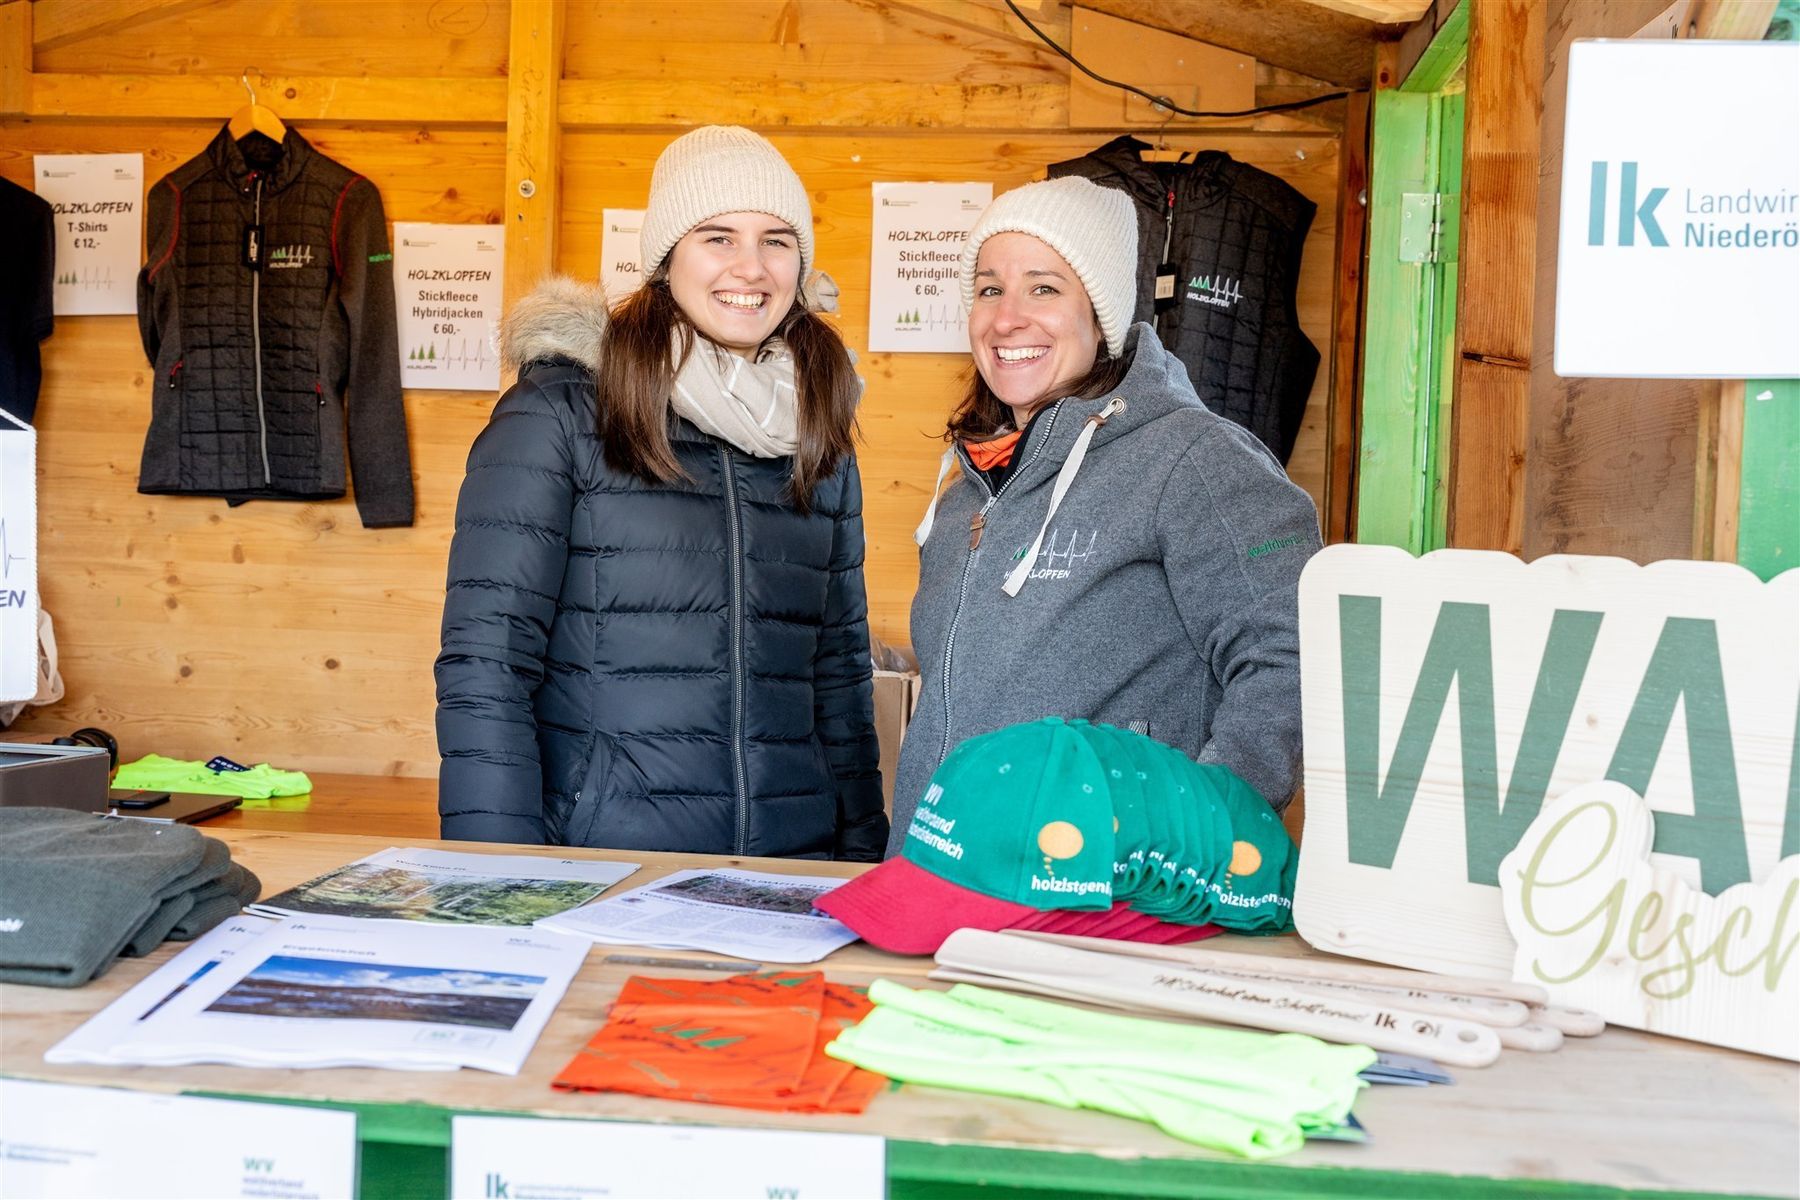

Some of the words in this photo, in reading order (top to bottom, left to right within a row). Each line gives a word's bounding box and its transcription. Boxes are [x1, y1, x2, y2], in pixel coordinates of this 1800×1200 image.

[50, 202, 133, 214] OLZKLOPFEN
[1588, 161, 1670, 247] lk
[1686, 188, 1800, 214] Landwir
[68, 222, 108, 232] T-Shirts
[1685, 222, 1799, 248] Niederö
[74, 238, 80, 248] €
[83, 238, 101, 249] 12,-
[408, 270, 492, 281] HOLZKLOPFEN
[418, 290, 479, 302] Stickfleece
[915, 284, 921, 295] €
[924, 284, 944, 296] 60,-
[1187, 291, 1230, 308] HOLZKLOPFEN
[412, 306, 483, 320] Hybridjacken
[433, 324, 439, 334] €
[442, 324, 461, 335] 60,-
[1338, 592, 1800, 898] WA
[1031, 875, 1112, 897] holzistgeni
[1375, 1012, 1397, 1030] lk
[486, 1173, 509, 1199] lk
